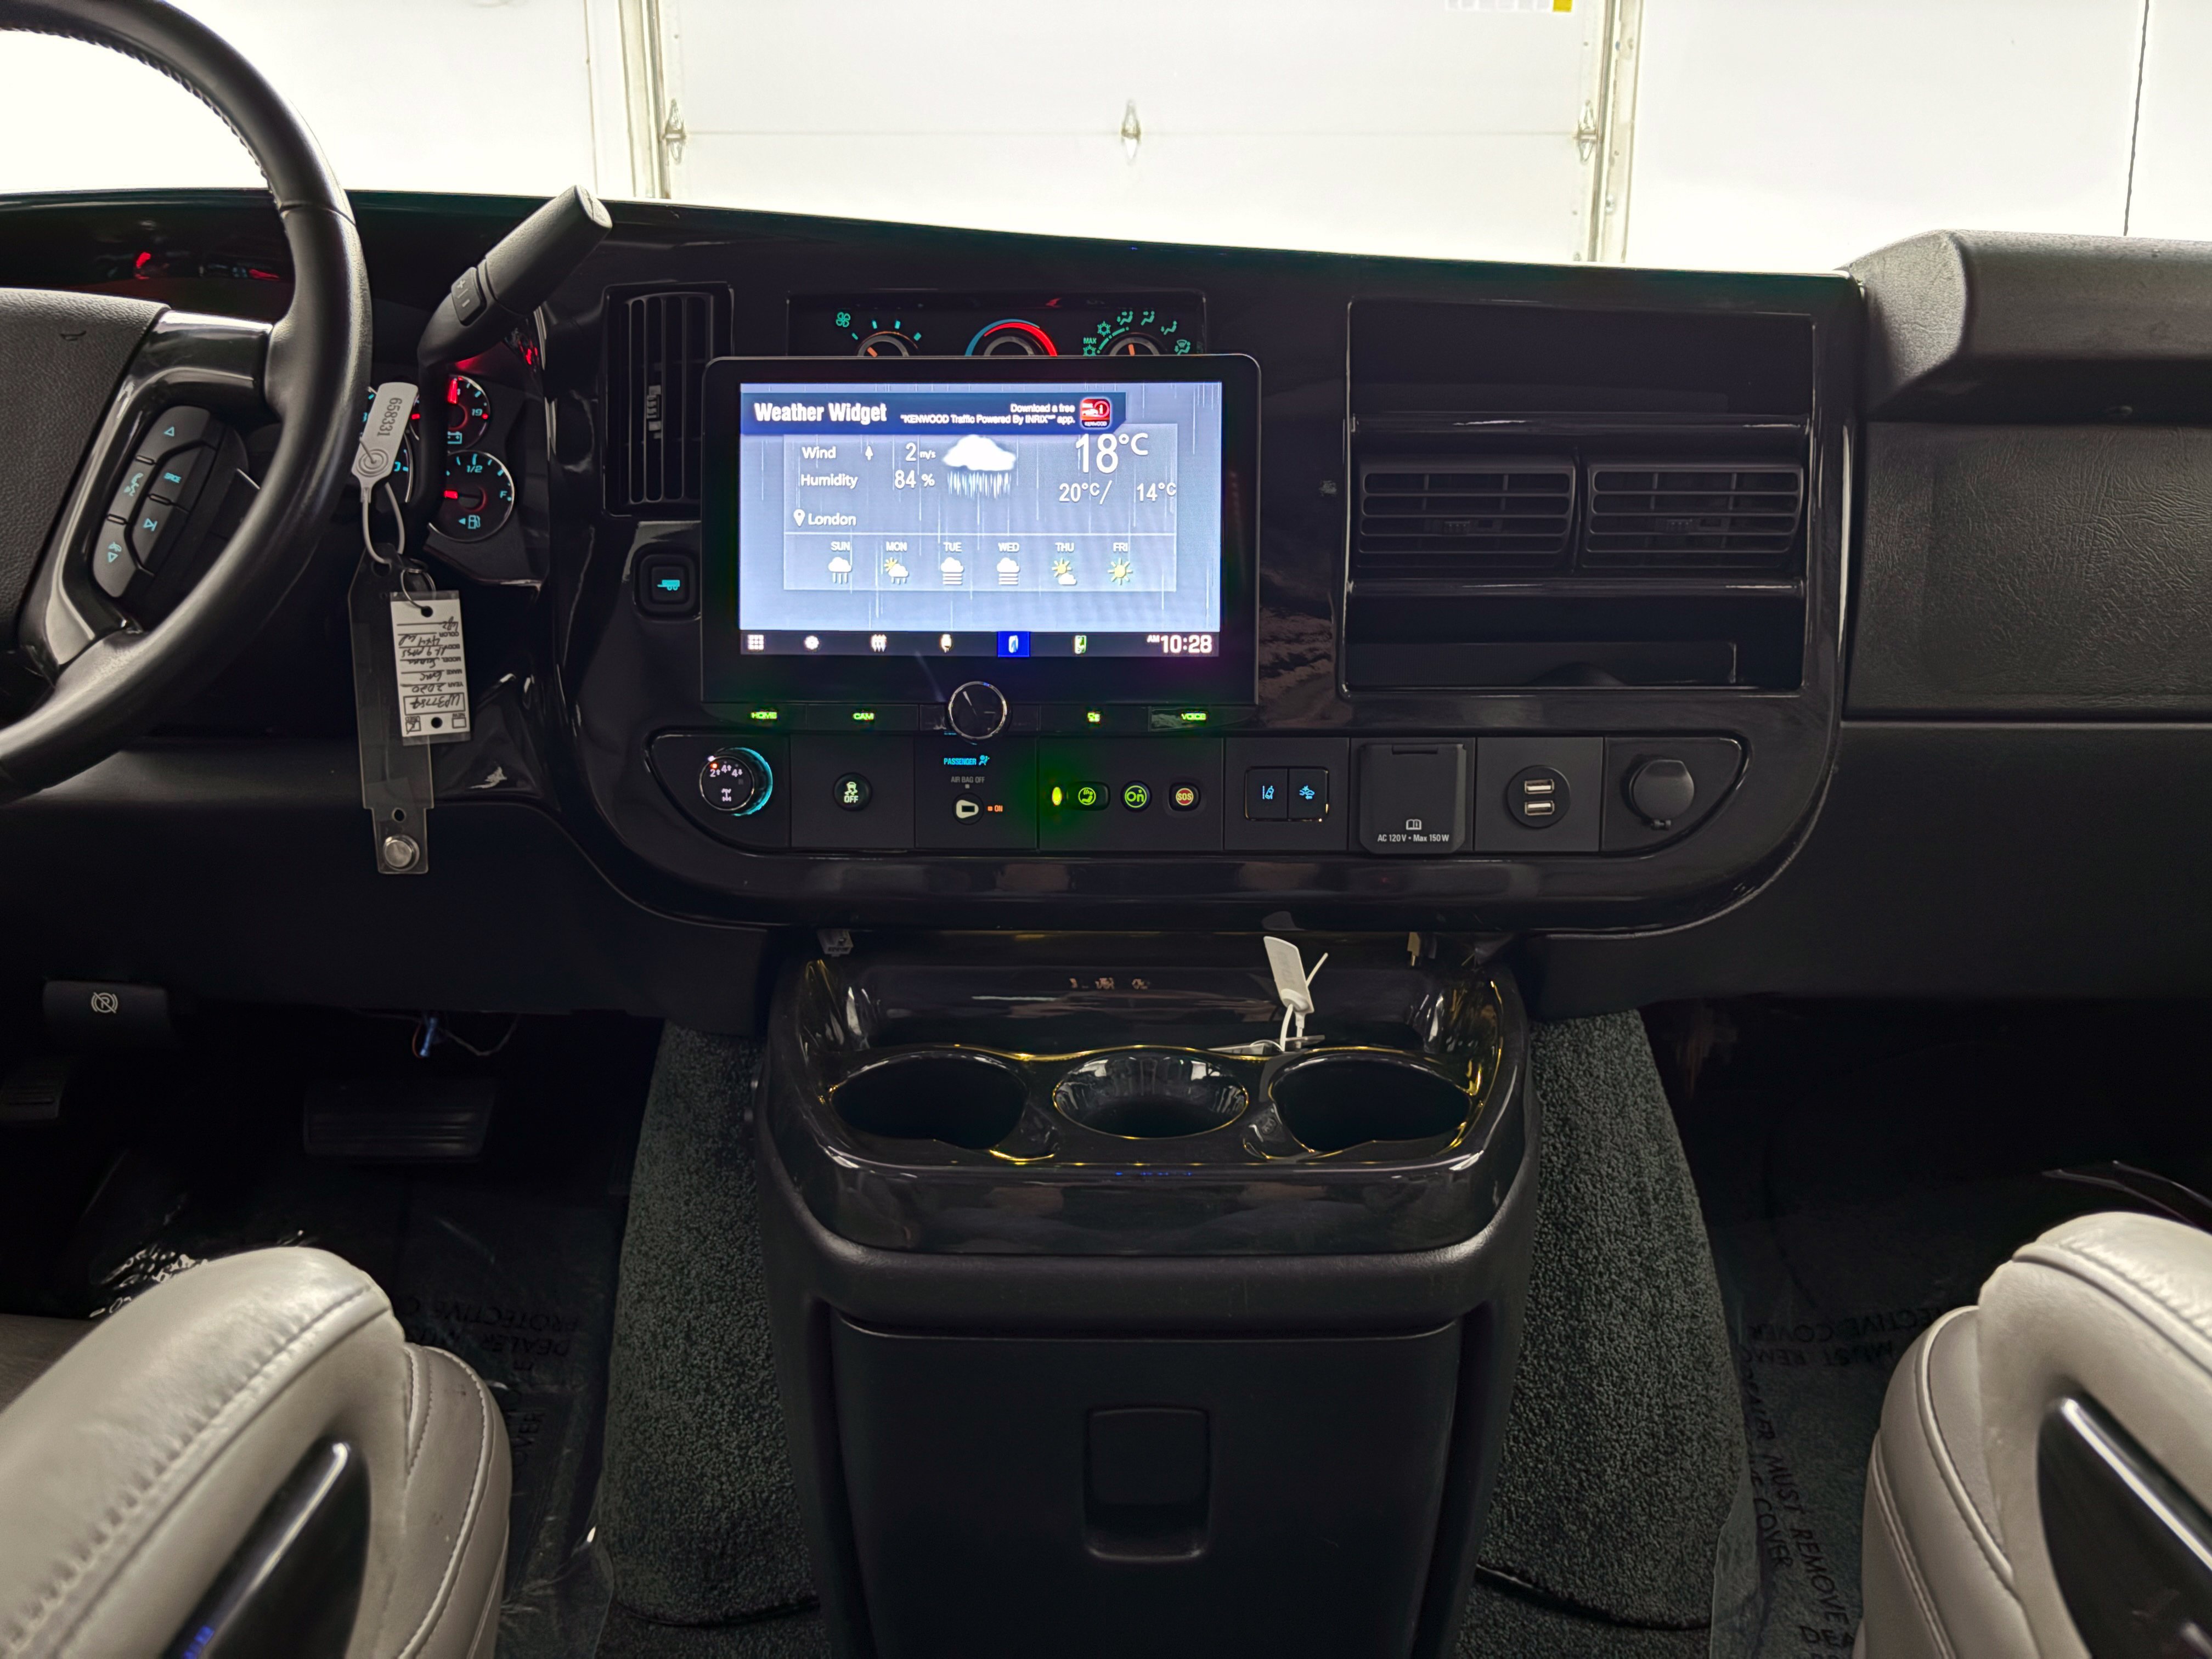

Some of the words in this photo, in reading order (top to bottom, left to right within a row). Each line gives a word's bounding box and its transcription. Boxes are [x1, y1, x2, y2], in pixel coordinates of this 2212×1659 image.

[1083, 336, 1097, 345] MAX
[754, 403, 824, 422] Weather
[828, 403, 887, 425] Widget
[1011, 404, 1051, 413] Download
[1059, 404, 1075, 413] free
[377, 397, 403, 437] 658331
[951, 414, 975, 424] Traffic
[977, 415, 1011, 424] Powered
[1012, 415, 1024, 426] By
[1057, 416, 1075, 425] app.
[802, 446, 836, 459] Wind
[905, 443, 917, 461] 2
[919, 451, 936, 460] m/s
[800, 473, 859, 489] Humidity
[894, 470, 916, 488] 84
[922, 474, 935, 487] %
[808, 513, 856, 526] London
[831, 541, 850, 551] SUN
[886, 541, 907, 551] MON
[943, 541, 962, 552] TUE
[997, 542, 1019, 552] WED
[1055, 542, 1074, 552] THU
[1113, 542, 1128, 552] FRI
[1147, 634, 1160, 642] AM
[1160, 634, 1212, 653] 10:28
[944, 757, 977, 765] PASSENGER
[844, 795, 859, 803] OFF
[1177, 792, 1193, 801] SOS
[1753, 1498, 1793, 1568] COVER
[1763, 1454, 1806, 1515] MUST
[1789, 1527, 1850, 1624] REMOVE
